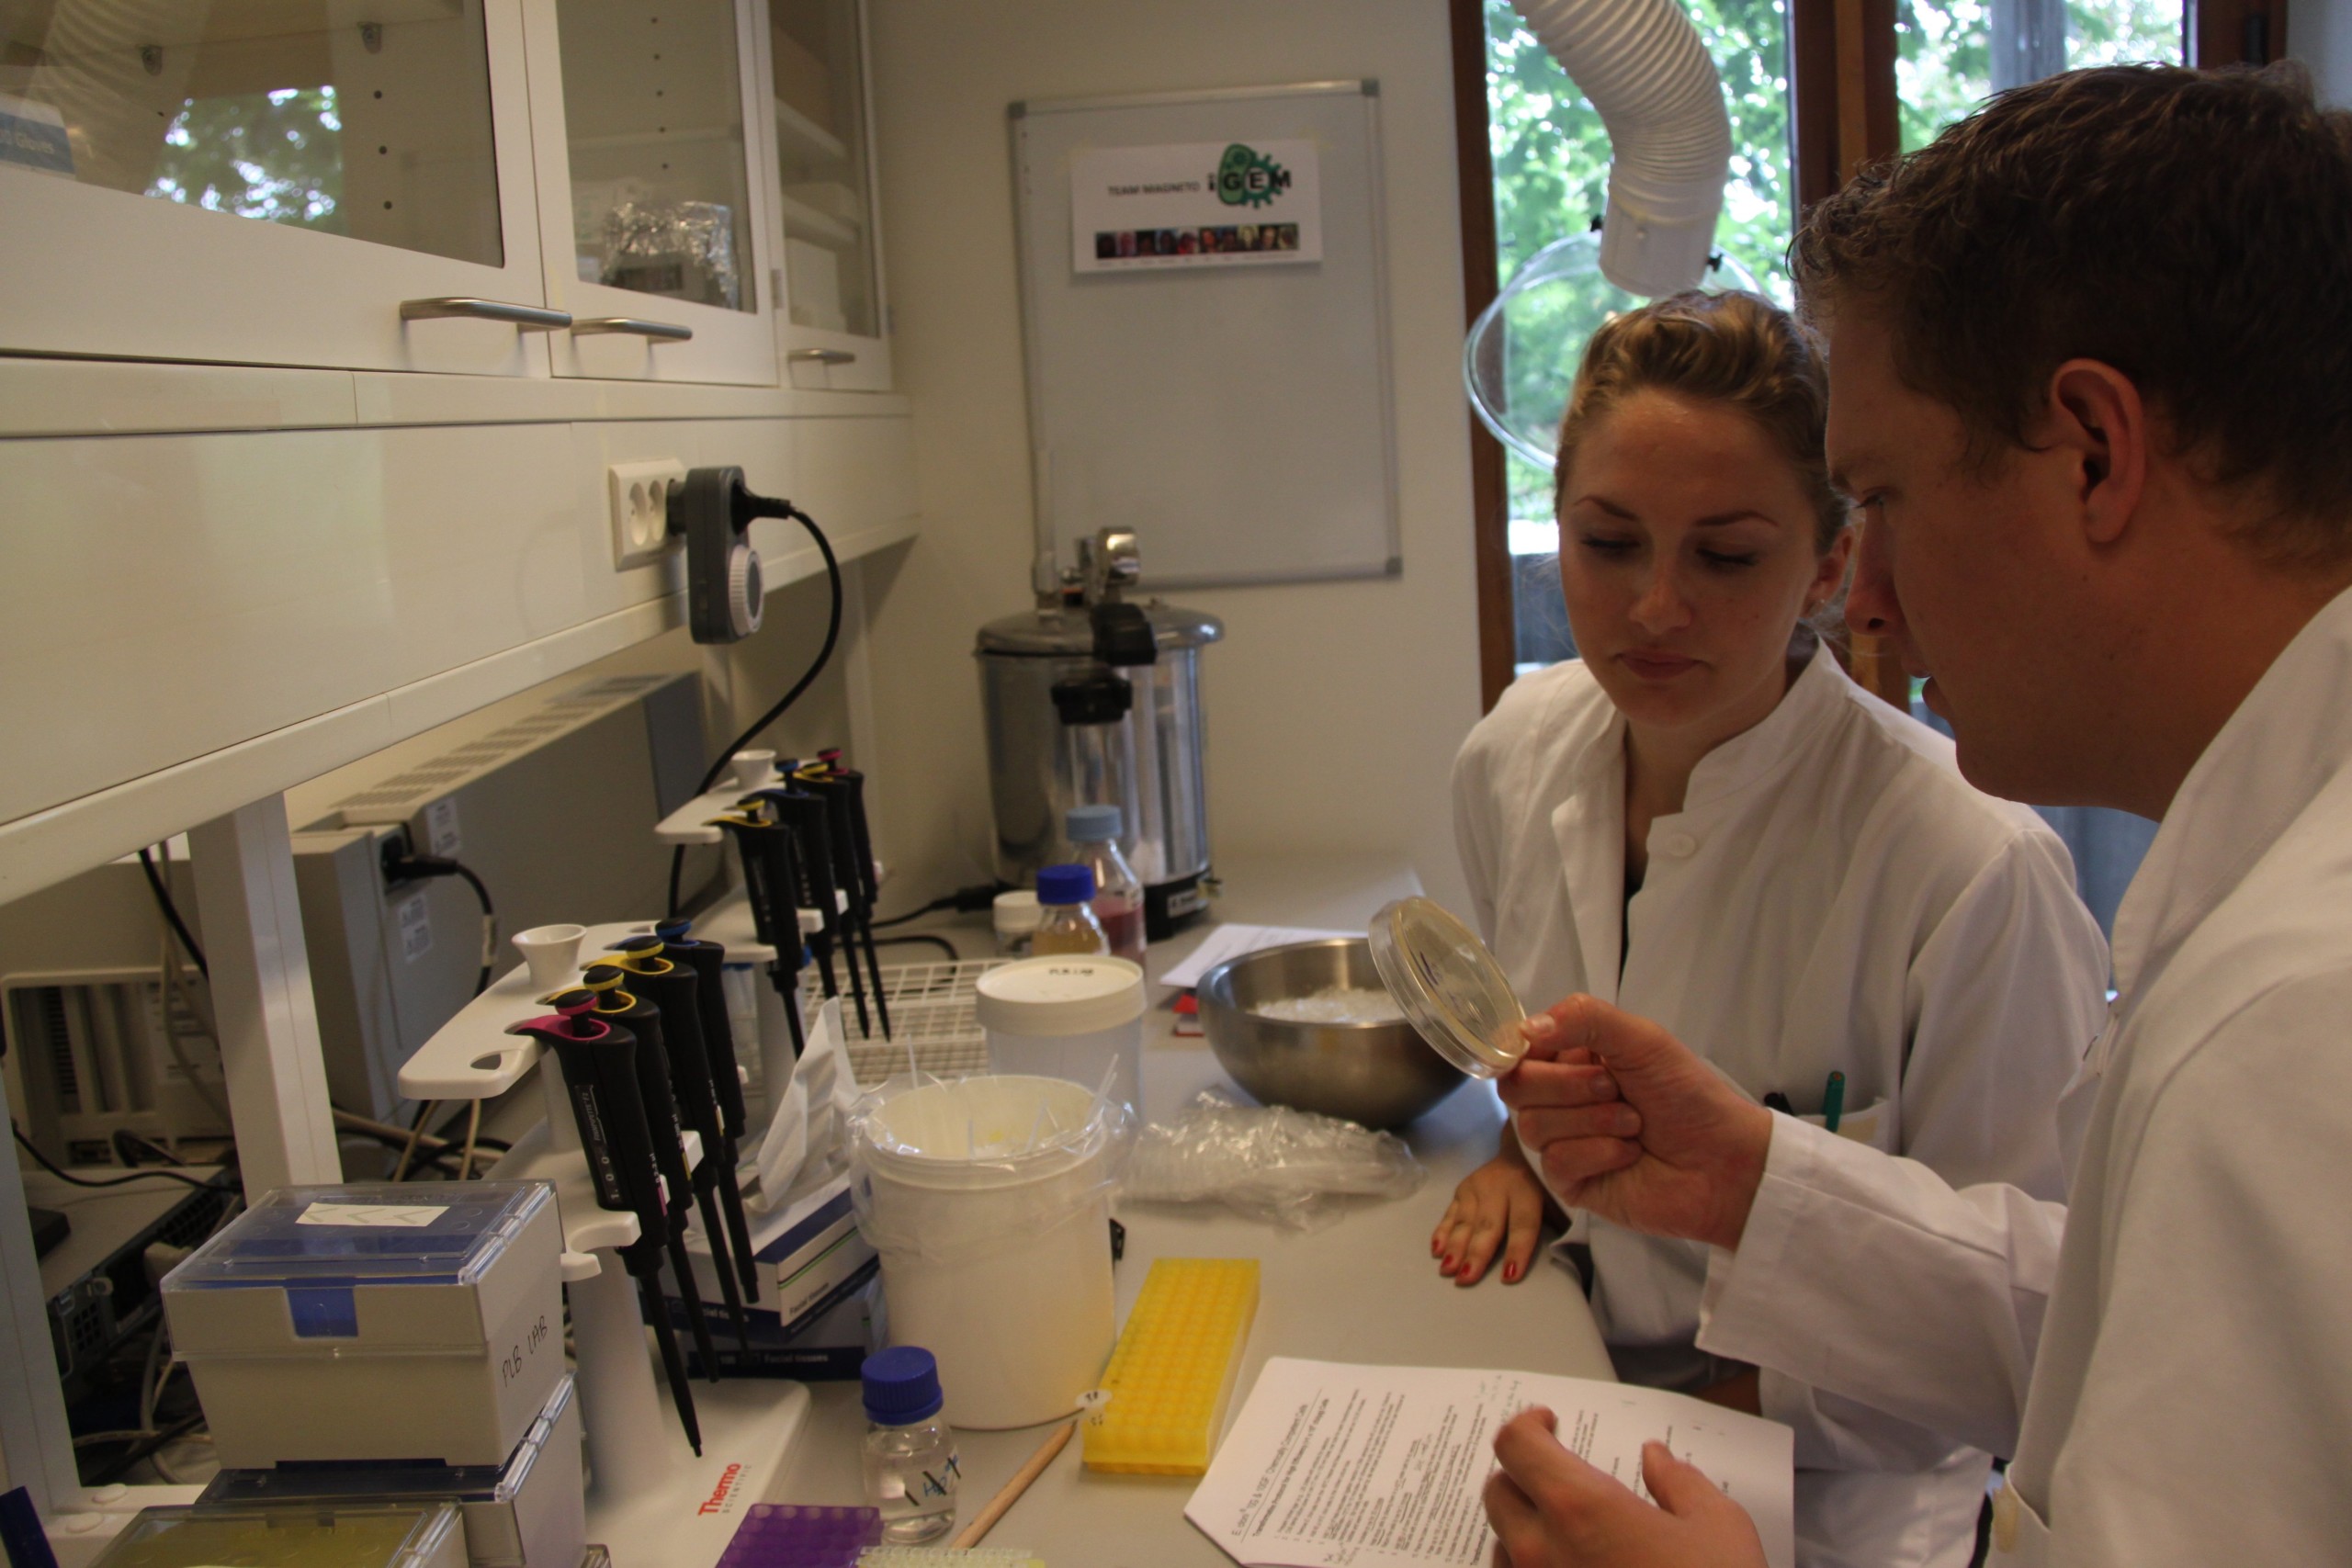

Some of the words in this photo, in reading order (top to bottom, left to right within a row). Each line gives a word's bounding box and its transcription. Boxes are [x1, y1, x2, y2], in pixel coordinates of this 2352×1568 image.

[1107, 184, 1139, 196] TEAM
[1207, 169, 1292, 191] iGEM
[698, 1462, 741, 1516] Thermo
